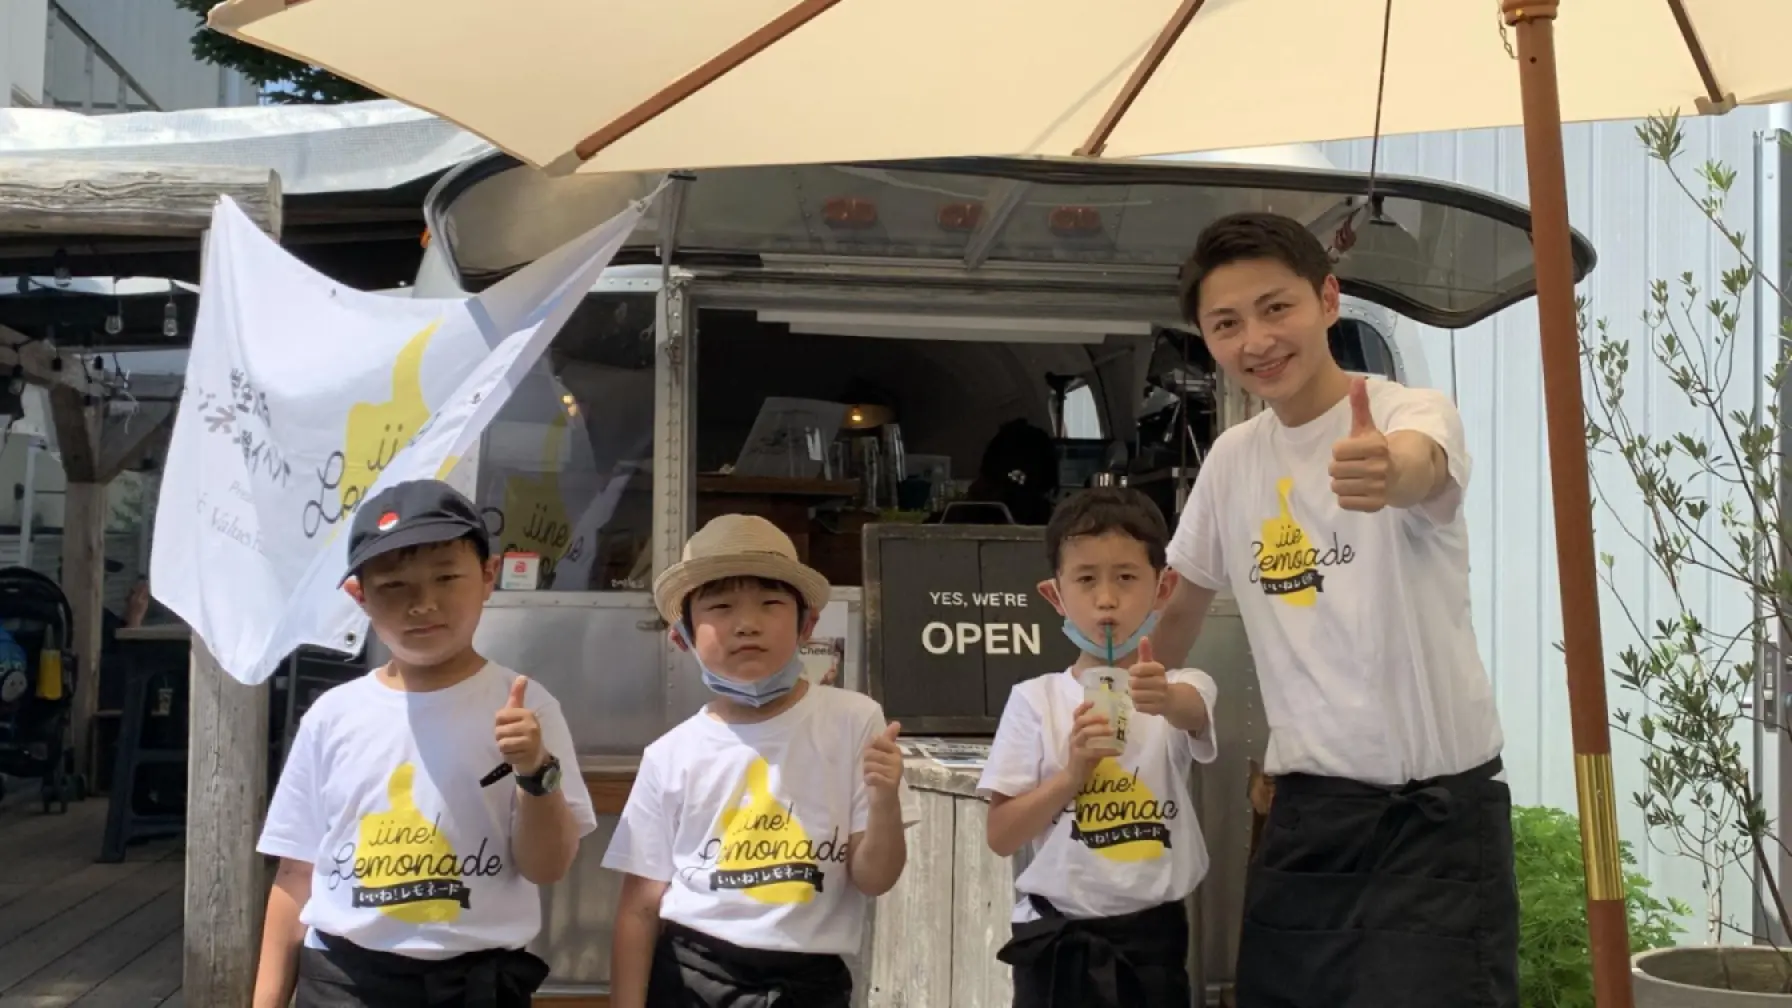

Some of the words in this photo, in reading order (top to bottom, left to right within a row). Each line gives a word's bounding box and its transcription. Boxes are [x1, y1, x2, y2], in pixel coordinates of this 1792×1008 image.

[929, 592, 968, 608] YES,
[972, 592, 1028, 608] WE'RE
[921, 621, 1041, 655] OPEN
[369, 812, 441, 846] iine!
[328, 837, 503, 891] Lemonade
